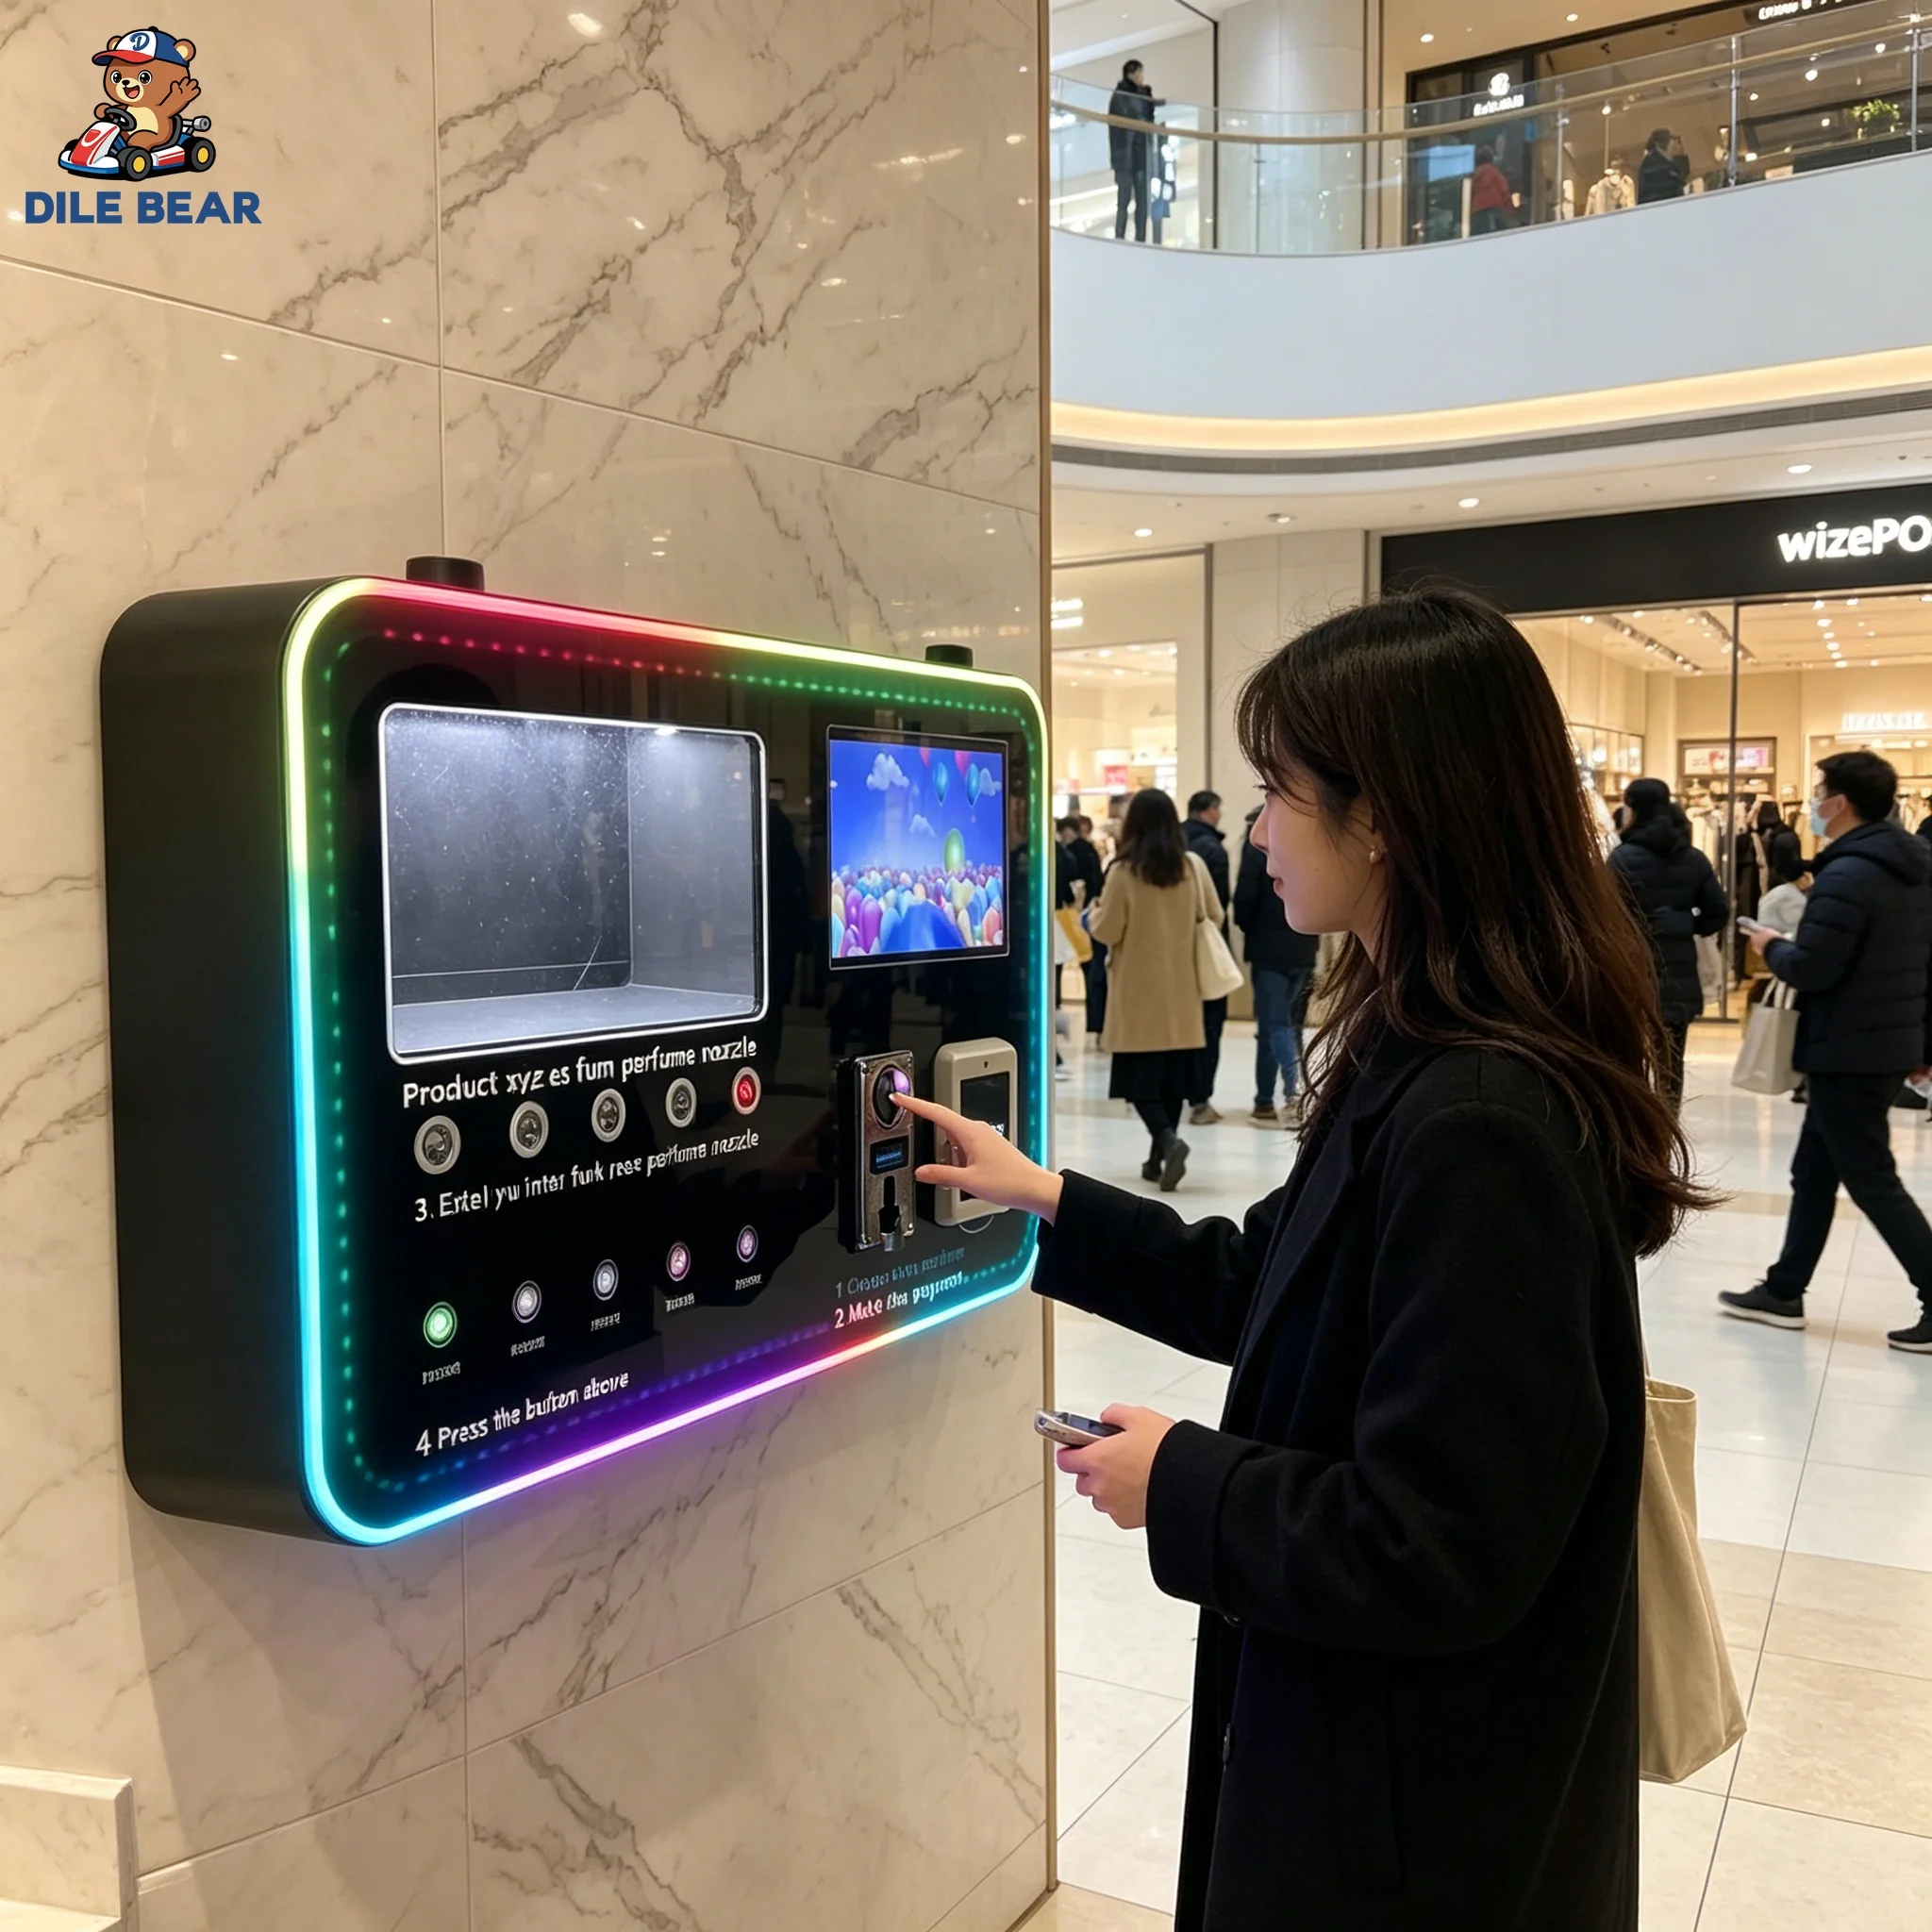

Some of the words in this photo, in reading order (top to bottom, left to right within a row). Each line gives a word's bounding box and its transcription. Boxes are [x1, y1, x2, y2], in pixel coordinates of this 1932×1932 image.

[1776, 514, 1932, 563] wizePO
[403, 1071, 498, 1108] Product
[506, 1070, 544, 1095] xyz
[548, 1066, 570, 1086] es
[622, 1045, 695, 1083] perfume
[414, 1197, 434, 1223] 3.
[415, 1429, 432, 1457] 4
[438, 1418, 489, 1450] Press
[493, 1407, 521, 1431] the
